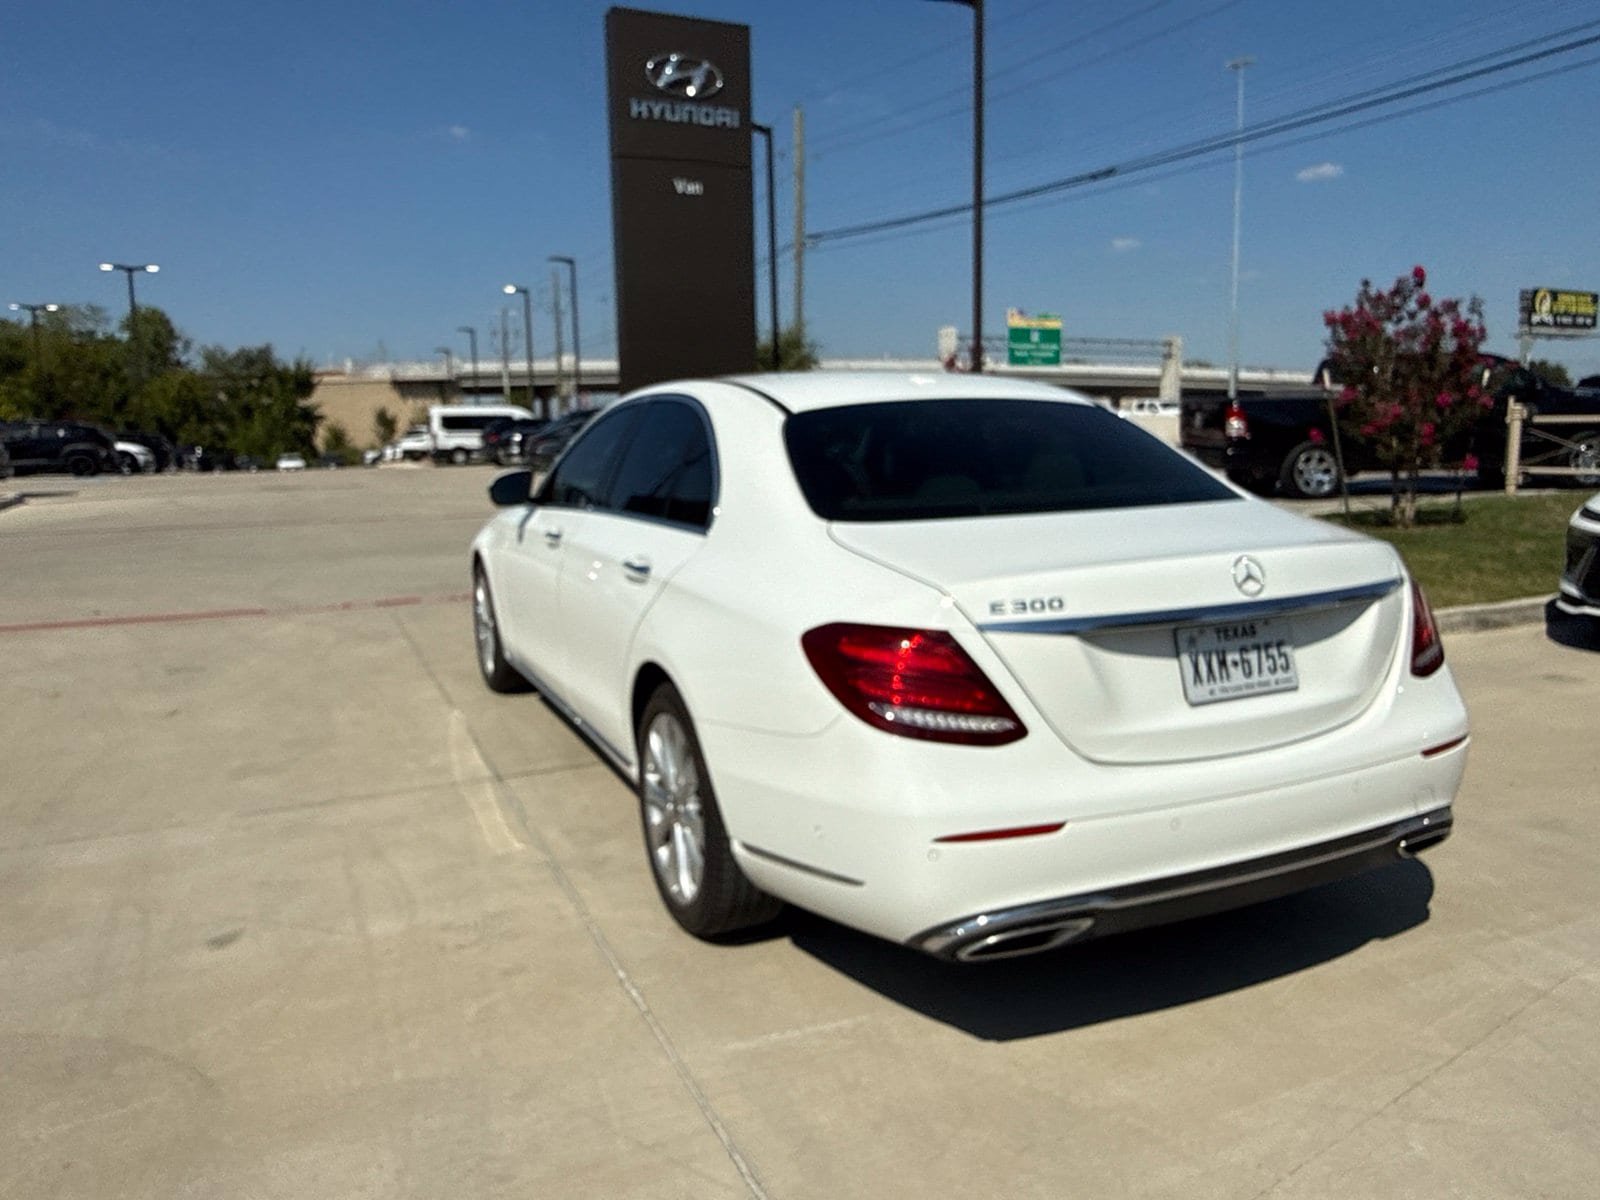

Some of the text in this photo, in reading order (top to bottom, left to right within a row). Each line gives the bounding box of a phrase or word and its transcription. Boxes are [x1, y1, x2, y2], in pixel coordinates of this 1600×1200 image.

[629, 97, 741, 129] HYUNDAI
[989, 597, 1064, 616] E 300
[1215, 624, 1258, 642] TEXAS
